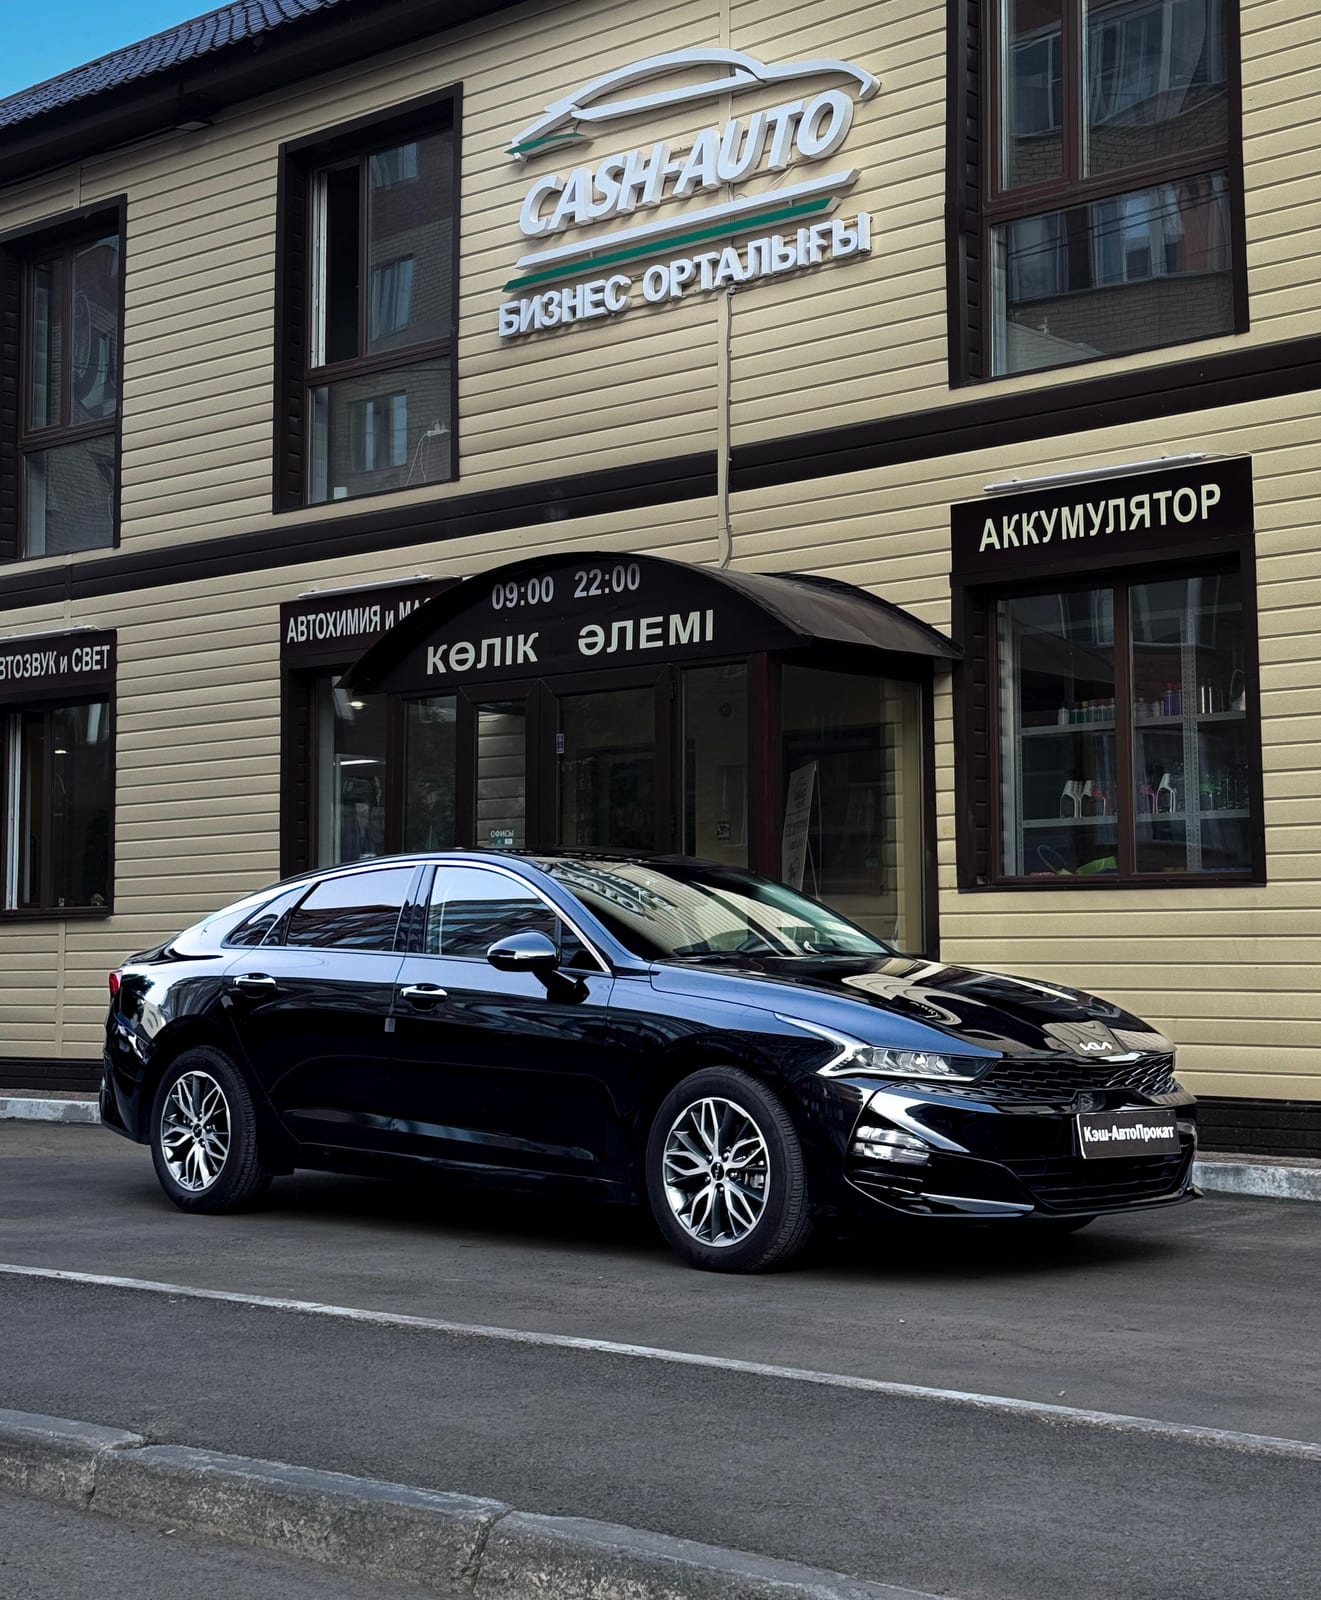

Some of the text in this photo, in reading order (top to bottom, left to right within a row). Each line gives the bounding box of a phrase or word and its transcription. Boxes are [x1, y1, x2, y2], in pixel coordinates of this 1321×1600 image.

[519, 90, 854, 238] CASH-AUTO
[499, 211, 873, 338] БИЗНЕС ОРТАЛЫҒЫ
[979, 483, 1221, 552] АККУМУЛЯТОР
[491, 563, 640, 610] 09:00 22:00
[286, 605, 381, 643] АВТОХИМИЯ
[385, 610, 394, 630] и
[427, 609, 714, 676] КӨЛІК ӘЛЕМІ
[60, 656, 68, 674] и
[72, 645, 110, 672] СВЕТ
[1083, 1124, 1175, 1142] Кэш-АвтоПрокат
